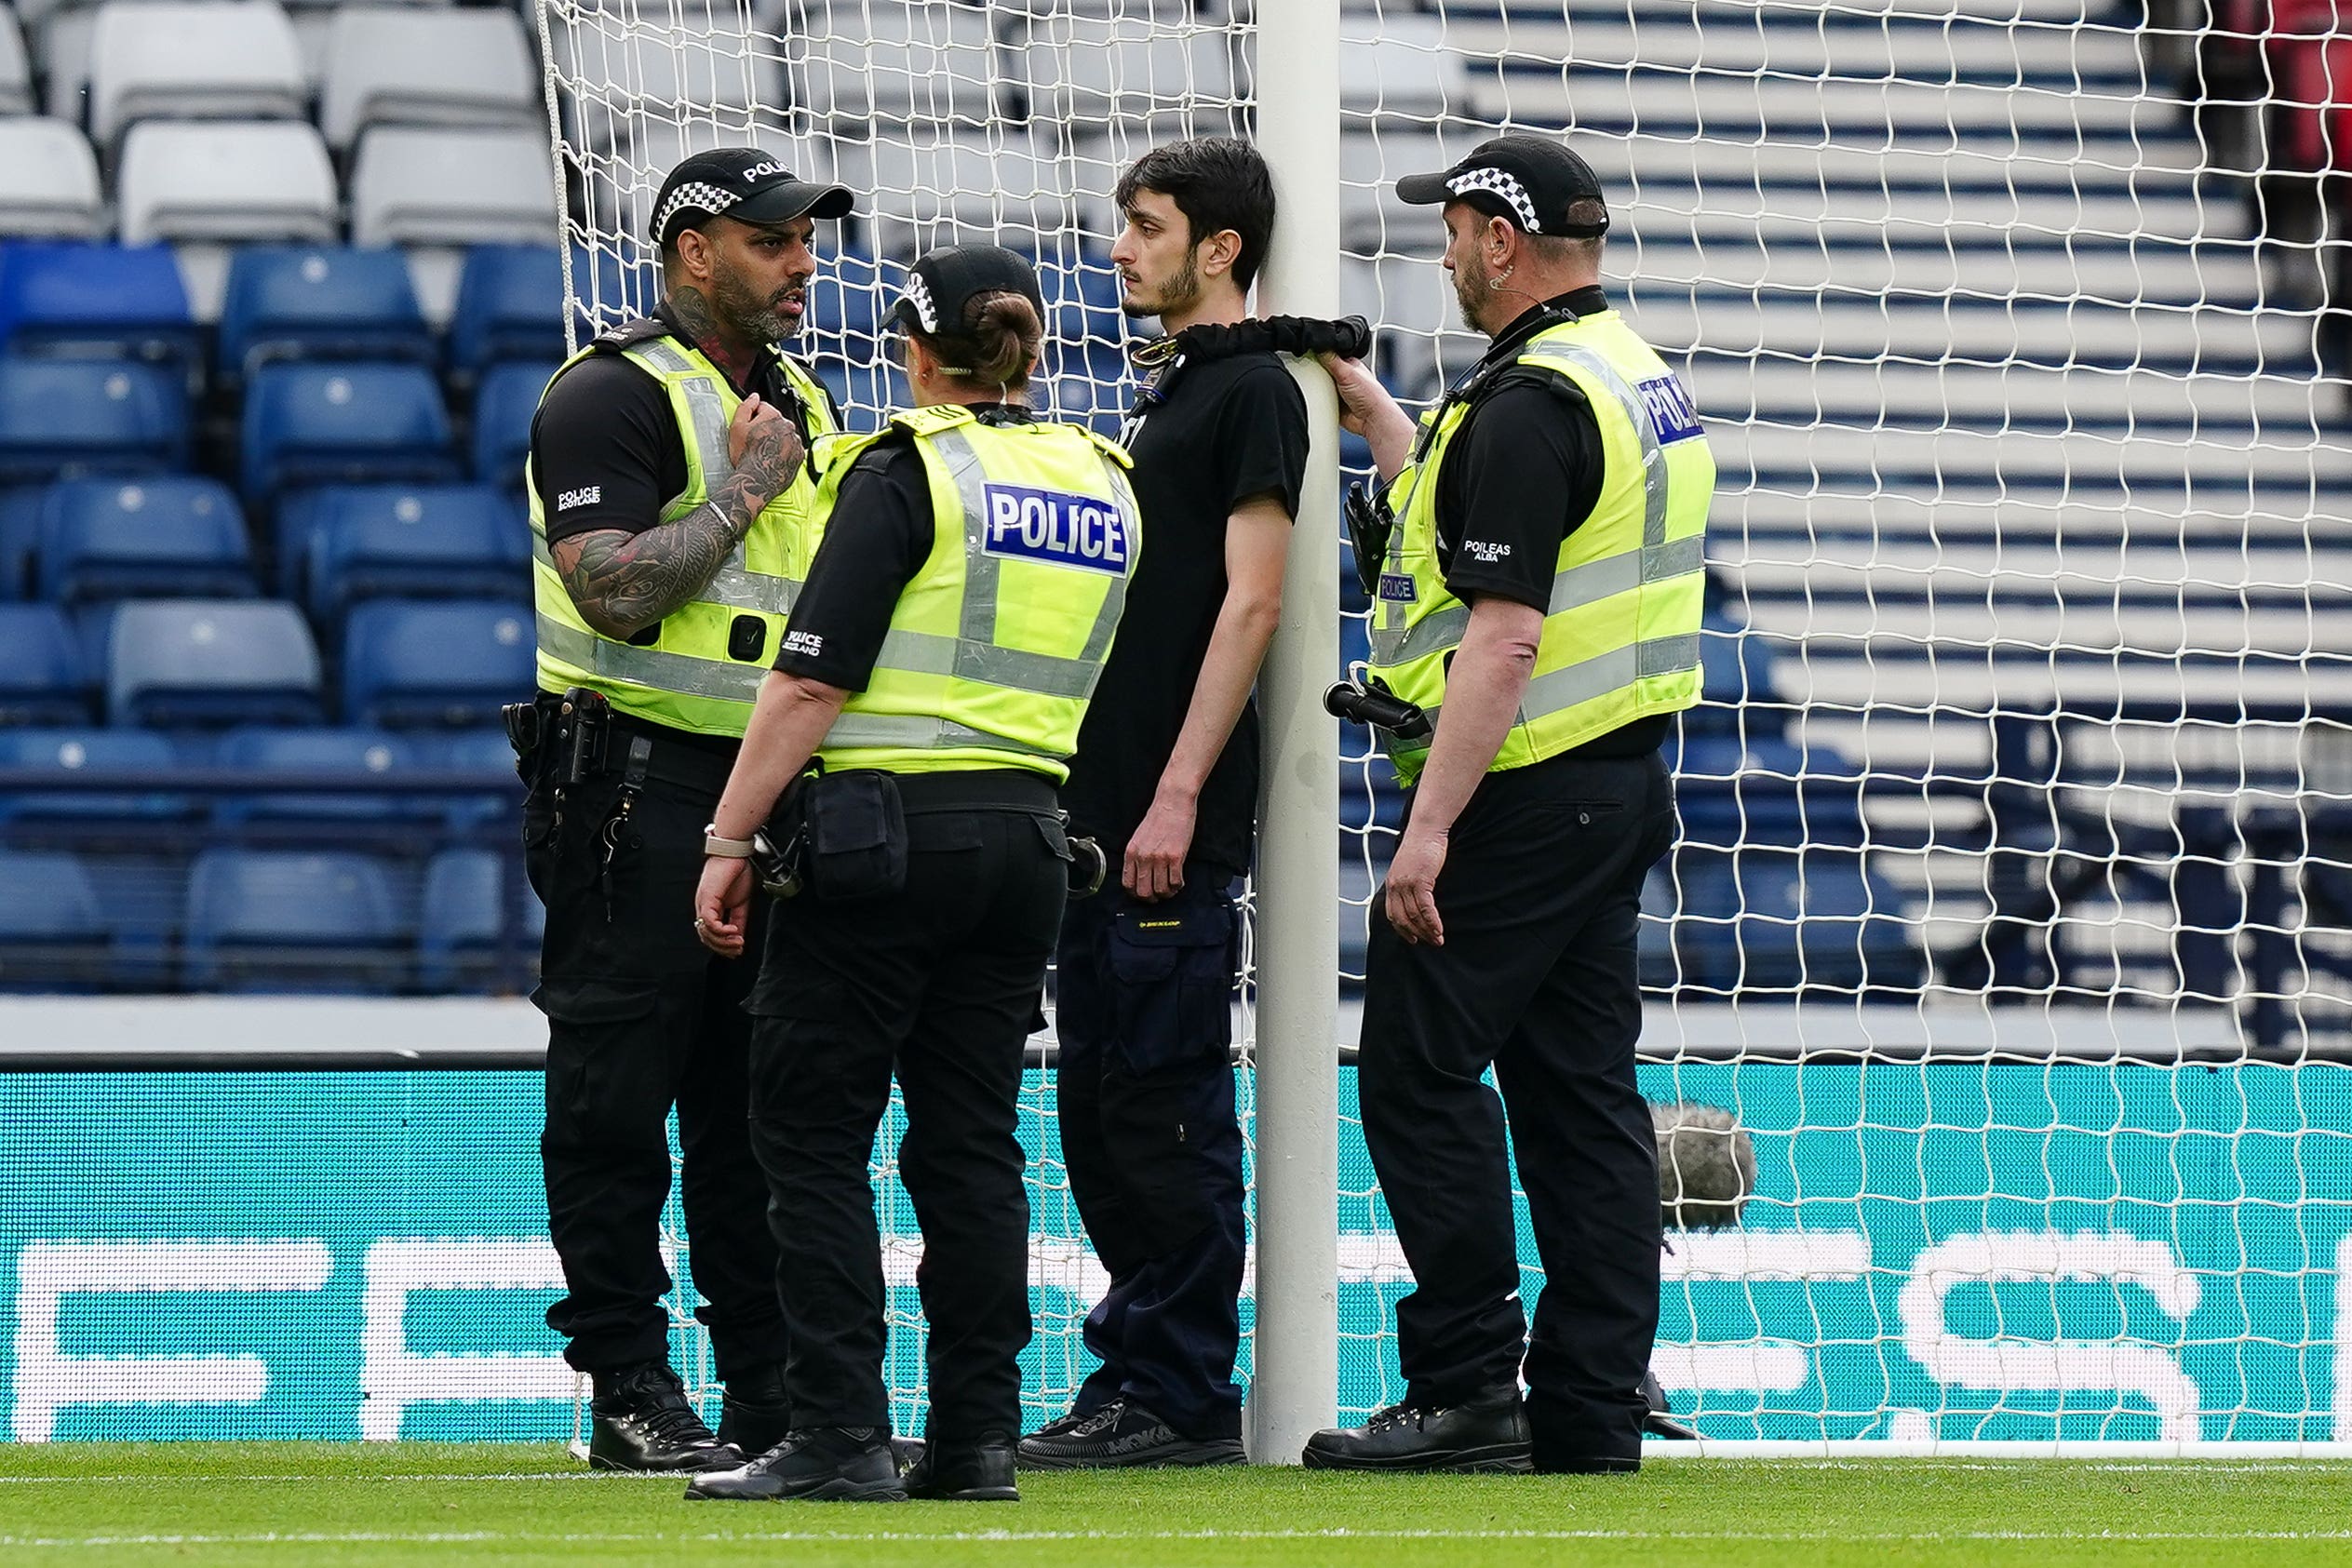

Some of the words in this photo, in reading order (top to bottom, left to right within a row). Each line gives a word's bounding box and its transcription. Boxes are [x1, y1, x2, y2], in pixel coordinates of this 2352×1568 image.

[743, 160, 789, 182] POLI
[558, 486, 600, 504] POLICE
[991, 492, 1124, 563] POLICE
[1464, 540, 1512, 556] POILEAS
[1473, 553, 1499, 563] ALBA
[1381, 578, 1412, 597] POLICE
[782, 641, 820, 657] LAND
